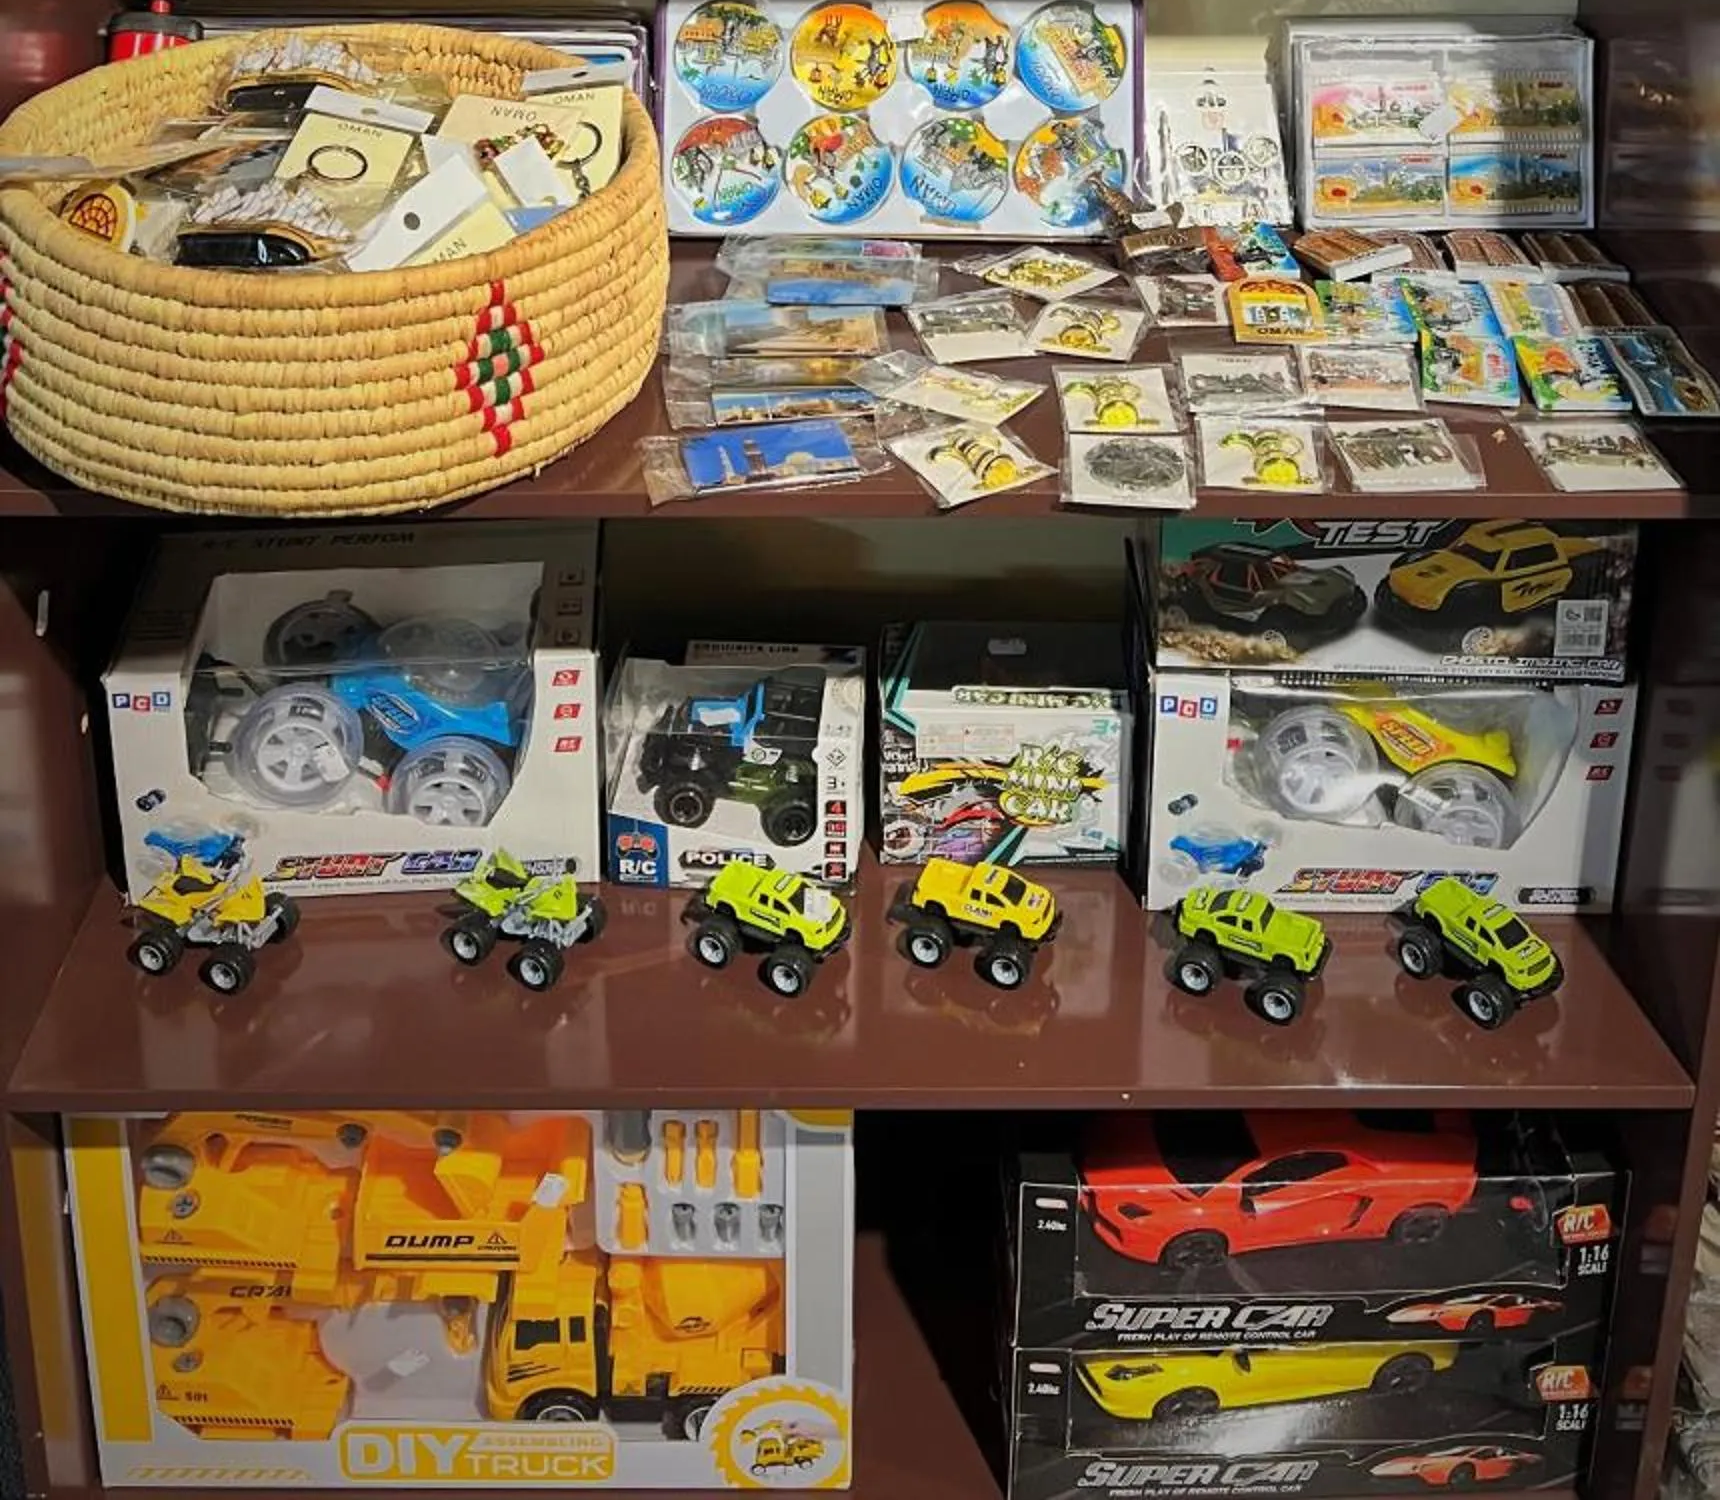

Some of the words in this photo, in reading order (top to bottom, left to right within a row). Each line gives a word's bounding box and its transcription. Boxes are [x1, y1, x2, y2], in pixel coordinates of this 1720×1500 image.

[552, 92, 595, 104] OMAN
[490, 104, 537, 121] OMAN
[337, 121, 383, 138] OMAN
[1256, 327, 1305, 336] OMAN
[1313, 520, 1442, 549] TEST
[1005, 769, 1083, 793] MINI
[1000, 793, 1074, 823] CAR
[619, 858, 657, 876] R/C
[684, 850, 769, 867] POLICE
[1562, 1209, 1595, 1234] R/C
[385, 1234, 475, 1249] DUMP
[1579, 1244, 1610, 1264] 1:16
[1085, 1303, 1231, 1331] SUPER
[1232, 1304, 1335, 1331] CAR
[1117, 1332, 1151, 1342] FRESH
[1153, 1332, 1181, 1342] PLAY
[1182, 1331, 1198, 1341] OF
[1199, 1331, 1242, 1341] REMOTE
[1243, 1331, 1291, 1340] CONTROL
[1293, 1330, 1316, 1339] CAR
[1541, 1370, 1575, 1390] R/C
[1558, 1403, 1590, 1421] 1:16
[350, 1432, 469, 1476] DIY
[464, 1454, 609, 1477] TRUCK
[1077, 1462, 1219, 1488] SUPER
[1220, 1460, 1320, 1487] CAR
[1109, 1488, 1143, 1498] FRESH
[1144, 1487, 1171, 1497] PLAY
[1172, 1487, 1187, 1496] OF
[1188, 1486, 1230, 1496] REMOTE
[1231, 1485, 1279, 1495] CONTROL
[1280, 1485, 1302, 1494] CAR
